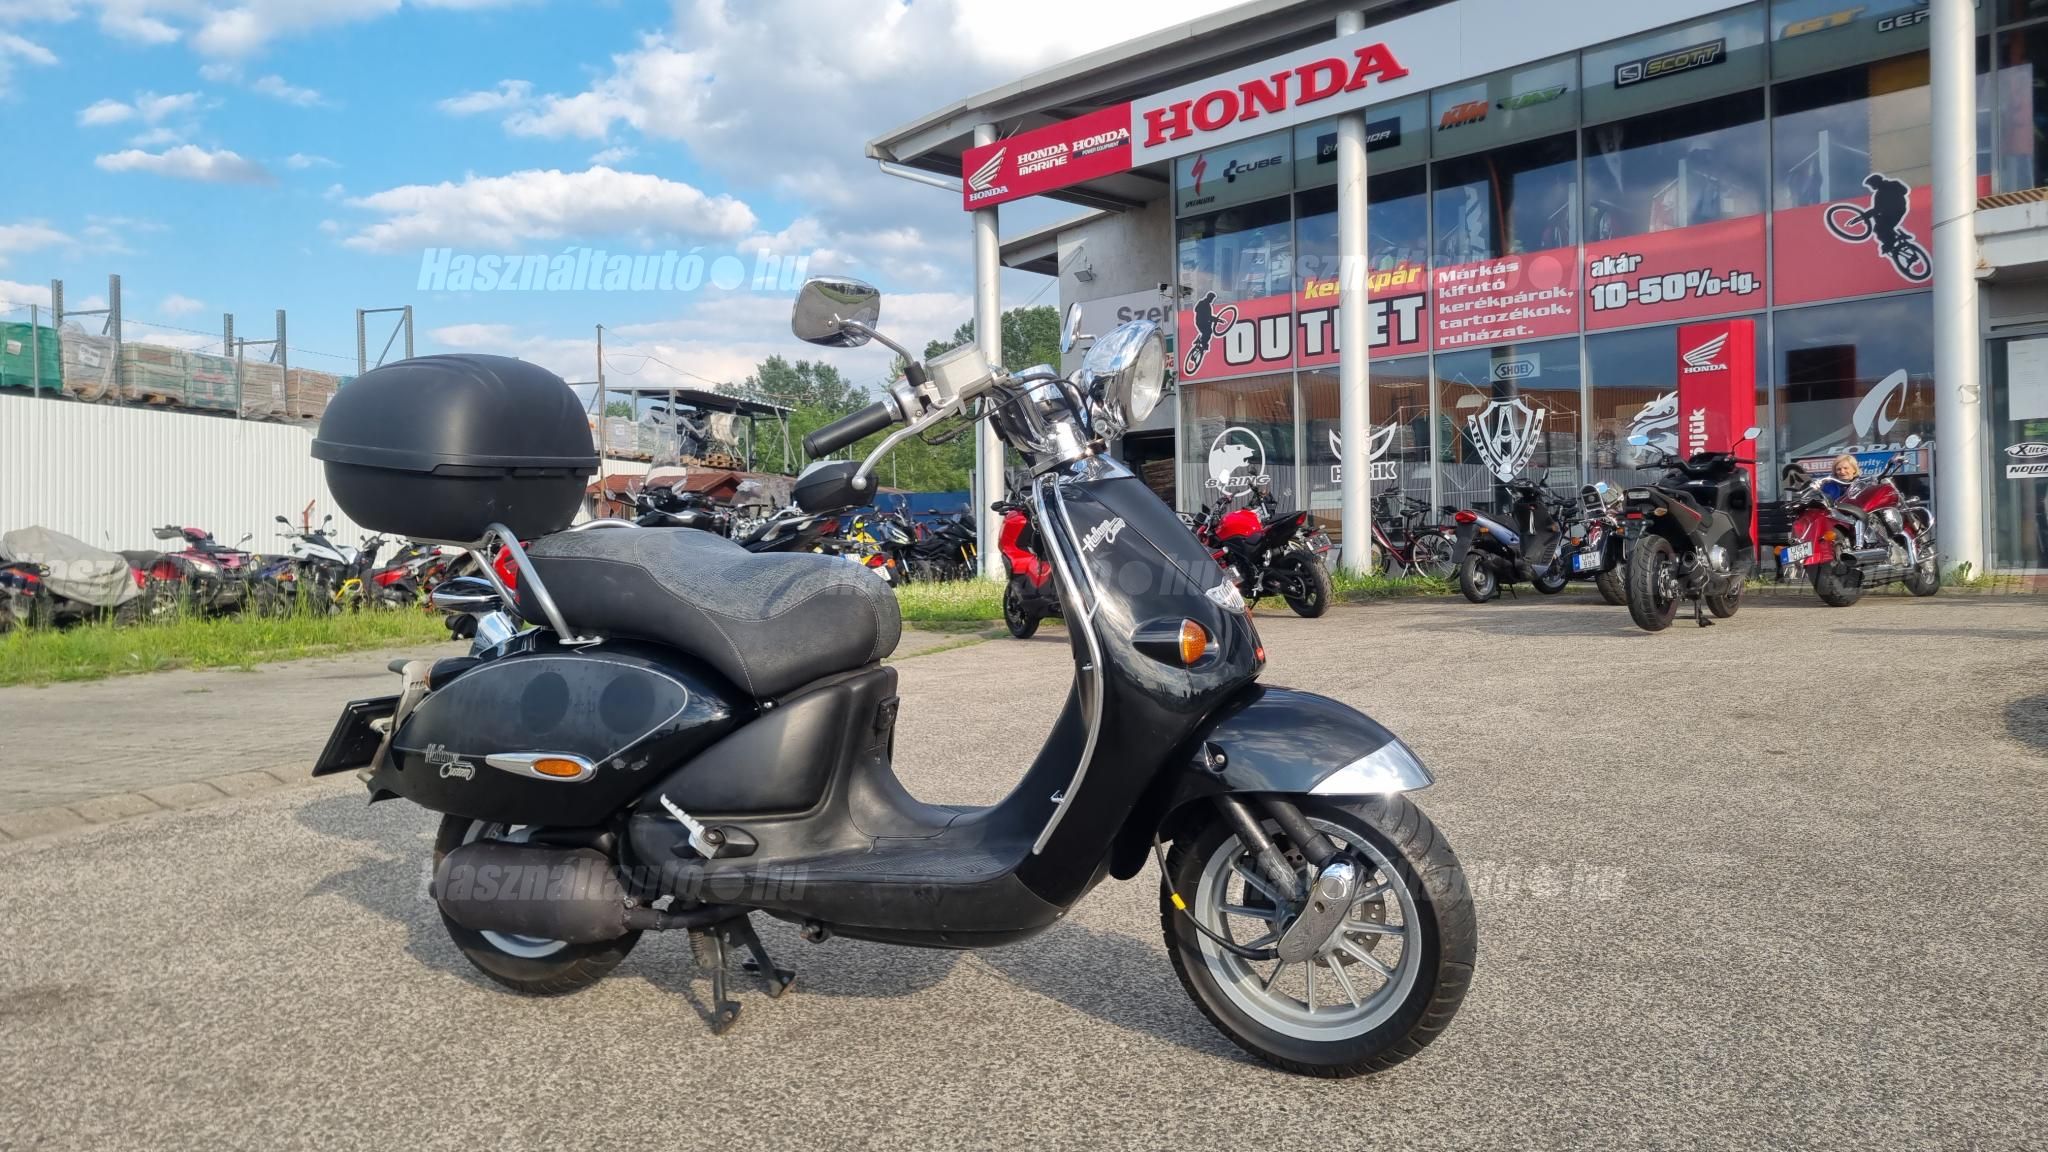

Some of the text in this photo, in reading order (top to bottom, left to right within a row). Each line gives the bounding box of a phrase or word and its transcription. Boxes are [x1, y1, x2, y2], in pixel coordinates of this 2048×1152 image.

[1878, 8, 1930, 33] GEP
[1646, 46, 1717, 75] SCOTT
[1144, 42, 1409, 148] HONDA
[1072, 128, 1129, 152] HONDA
[1017, 143, 1068, 165] HONDA
[1236, 155, 1283, 174] CUBE
[1018, 155, 1068, 177] MARINE
[969, 185, 1009, 202] HONDA
[1439, 261, 1520, 284] Márkás
[1591, 252, 1643, 278] akár
[1439, 278, 1506, 299] kifutó
[1590, 268, 1761, 312] 10-50%-ig.
[1439, 286, 1575, 314] kerékpárok,
[1440, 303, 1572, 330] tartozékok,
[1440, 324, 1534, 345] ruházat.
[1500, 363, 1530, 376] SHOEI
[1684, 363, 1728, 374] HONDA
[1205, 475, 1271, 489] BRING
